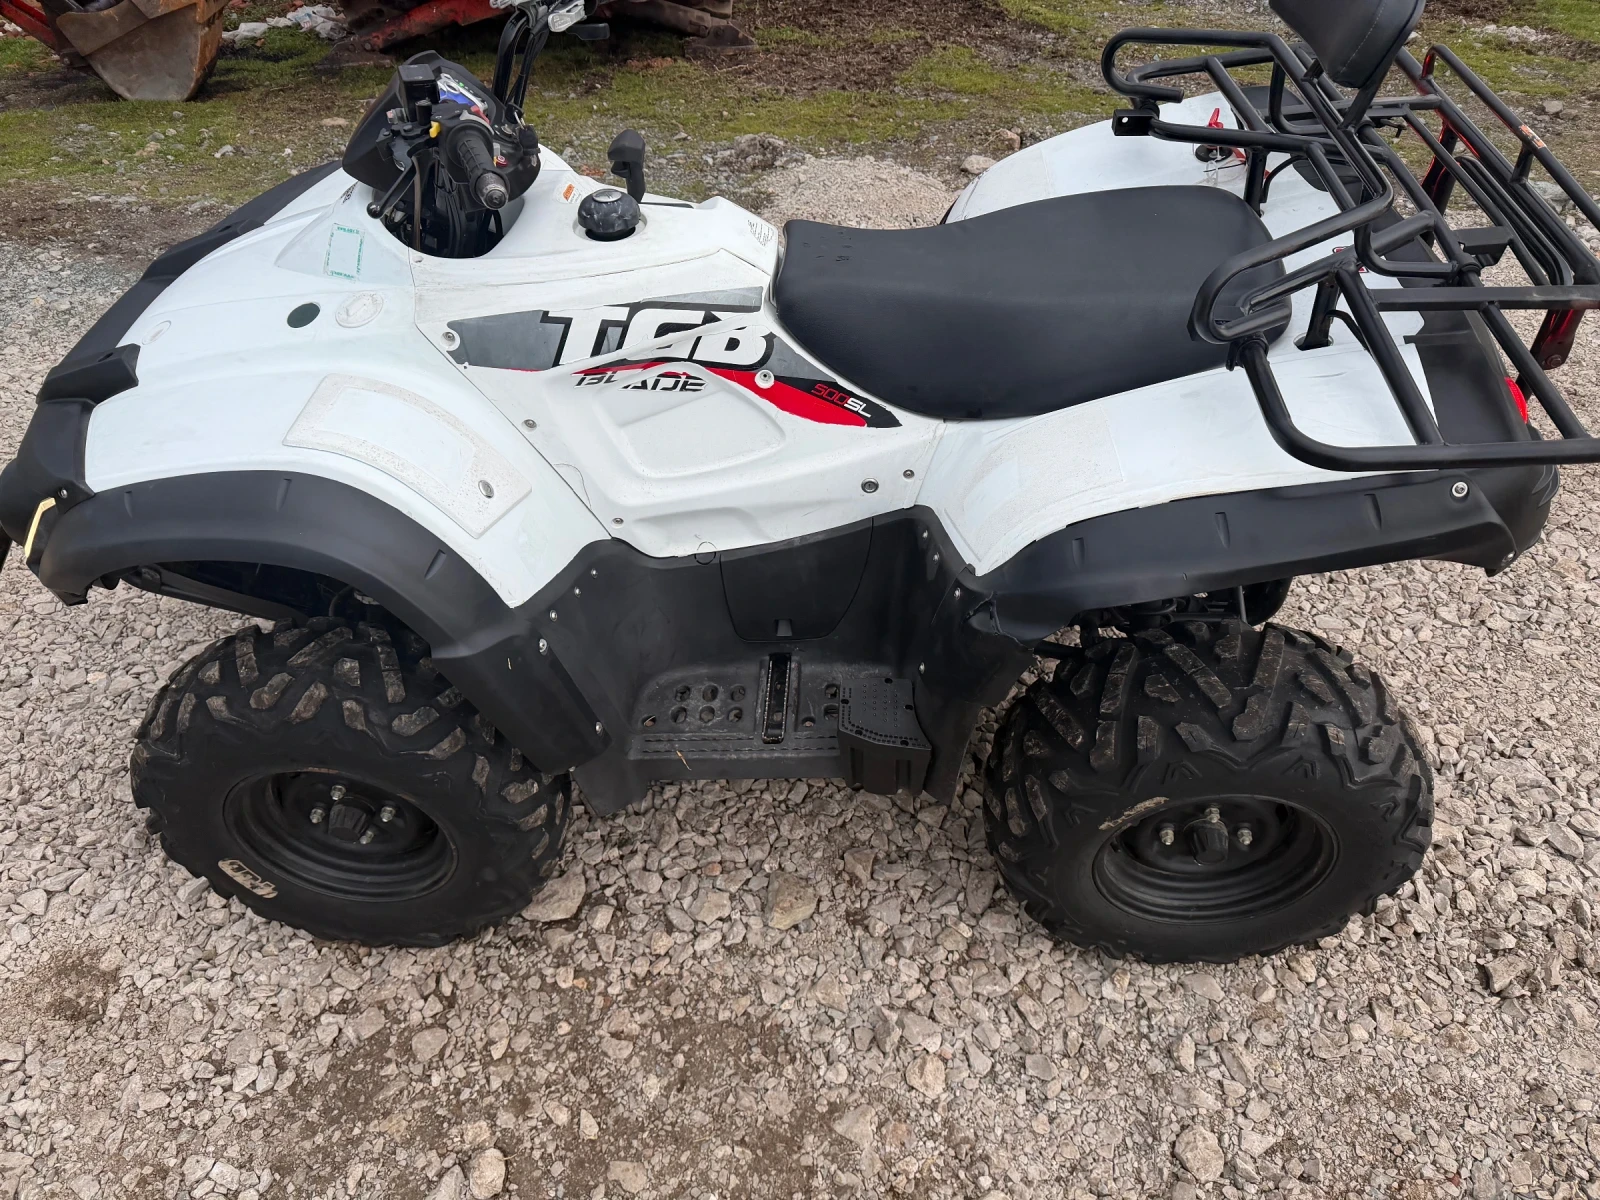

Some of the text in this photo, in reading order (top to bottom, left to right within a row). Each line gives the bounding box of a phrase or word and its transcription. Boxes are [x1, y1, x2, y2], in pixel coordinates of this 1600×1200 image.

[542, 301, 772, 368] TGB
[576, 371, 707, 392] BLADE
[811, 384, 872, 418] 500SL
